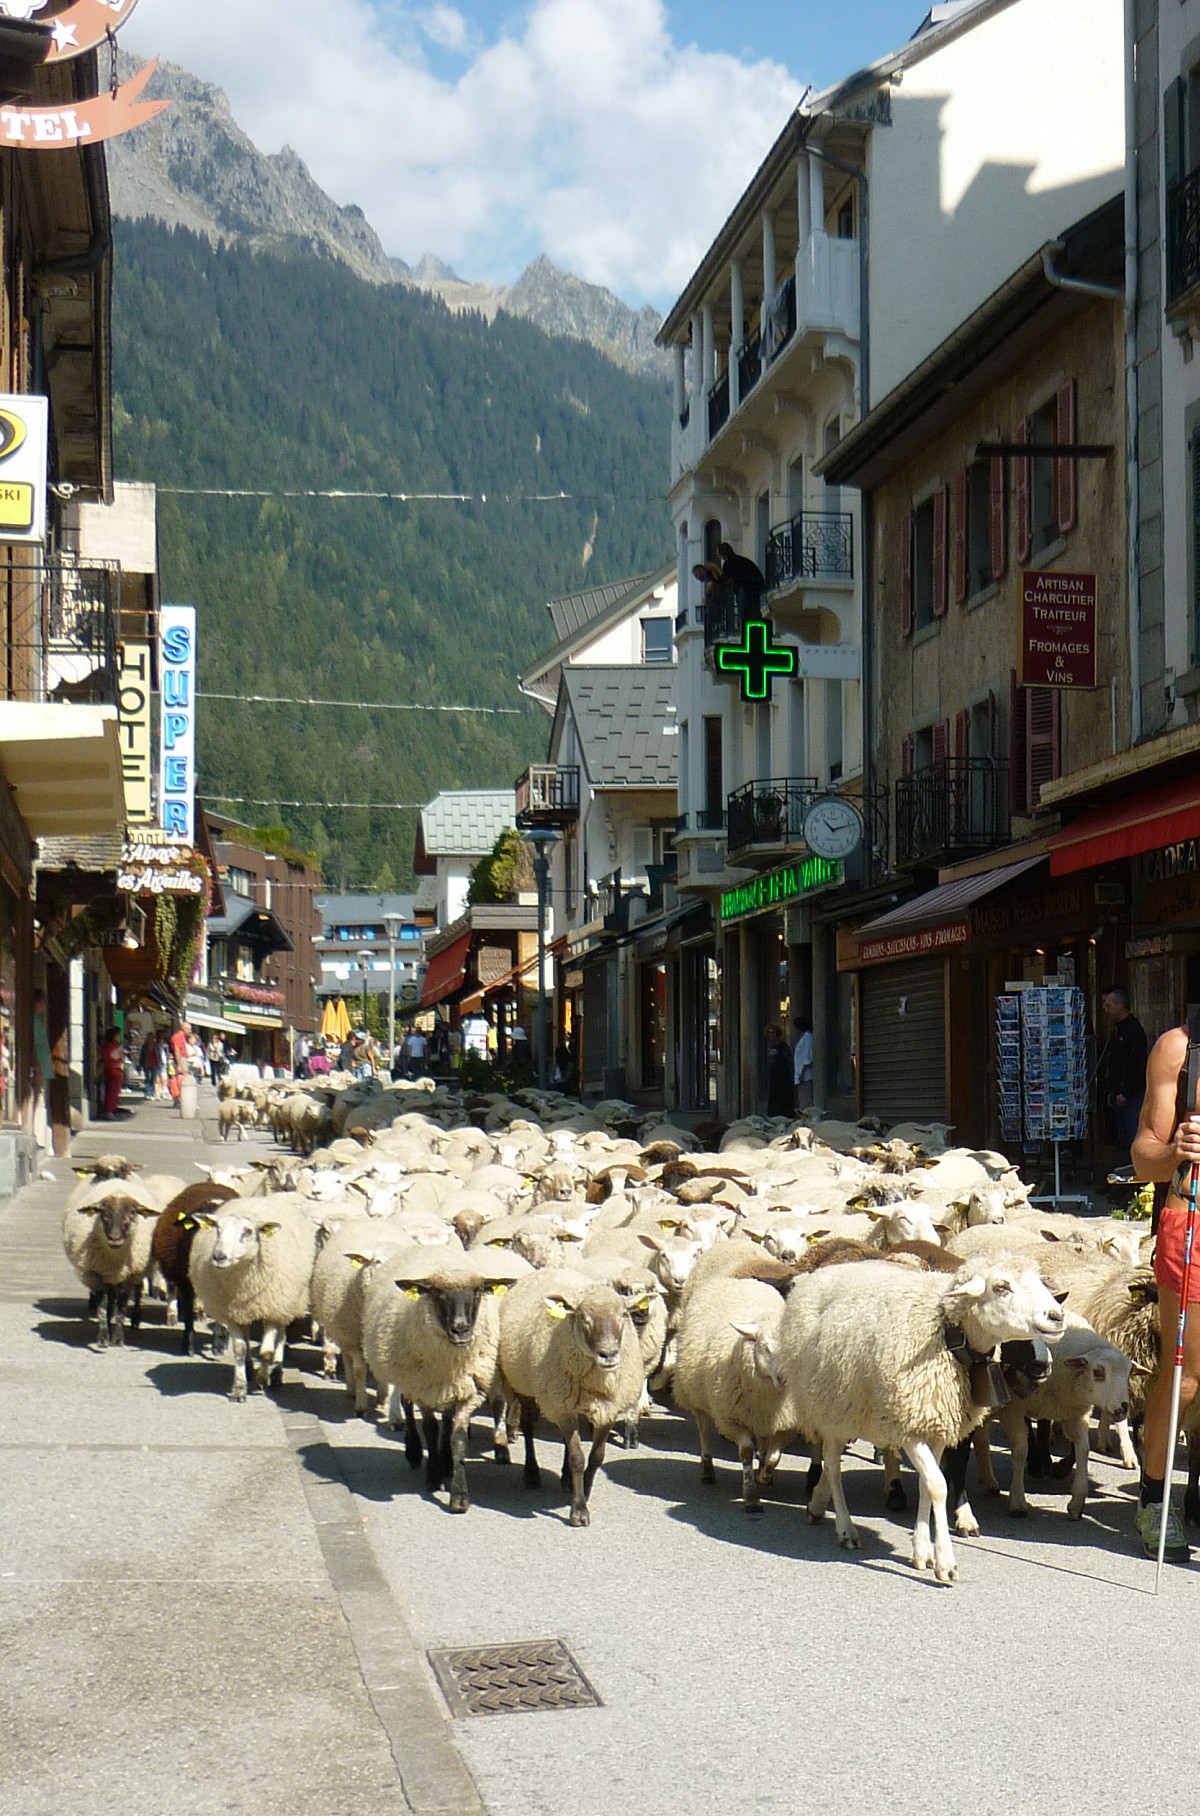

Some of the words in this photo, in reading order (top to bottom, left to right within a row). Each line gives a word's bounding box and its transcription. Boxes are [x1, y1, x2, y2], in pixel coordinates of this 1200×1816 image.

[1, 110, 92, 141] TEL
[1036, 577, 1084, 591] ARTISAN
[1024, 591, 1094, 606] CHARCUTIER
[1032, 607, 1087, 622] TRAITEUR
[1029, 640, 1090, 655] FROMAGES
[1054, 656, 1065, 668] &
[1046, 669, 1074, 684] VINS
[163, 626, 191, 835] SUPER
[132, 866, 203, 893] Aiguilles
[934, 925, 967, 946] FROMAGES
